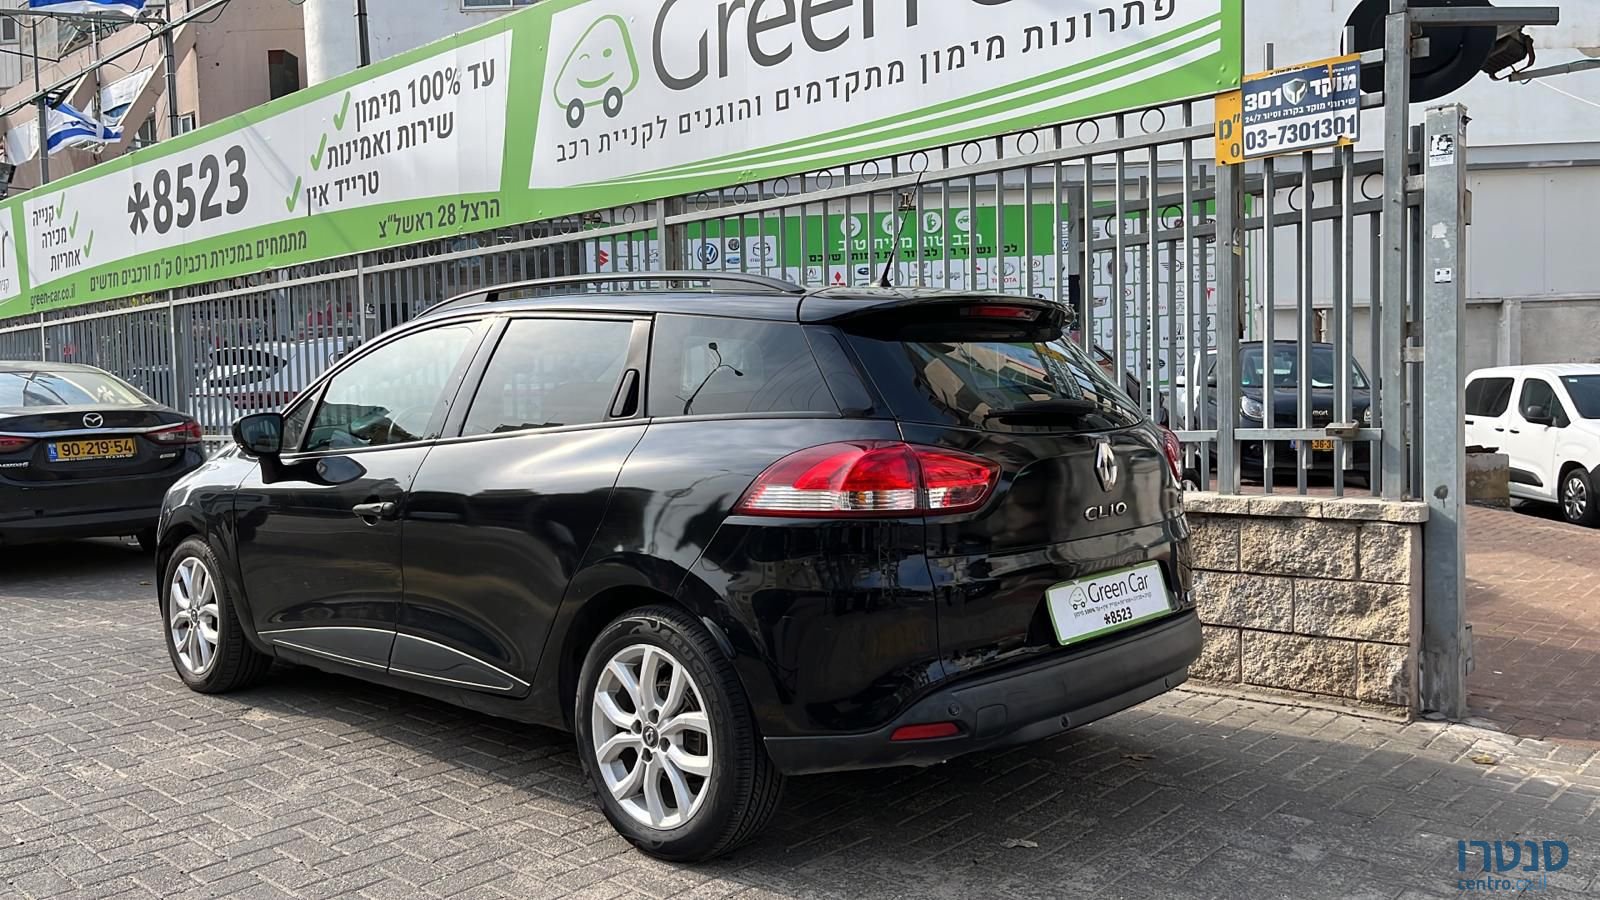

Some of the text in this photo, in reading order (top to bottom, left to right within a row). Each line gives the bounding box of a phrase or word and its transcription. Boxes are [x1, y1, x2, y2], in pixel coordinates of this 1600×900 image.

[556, 0, 1176, 163] פתרונות מימון מתקדמים והוגנים לקניית רכב
[354, 58, 495, 133] עד 100% מימון
[1244, 87, 1282, 112] 301
[1306, 102, 1326, 113] מוקד
[1245, 113, 1262, 124] 24/7
[1262, 110, 1281, 121] וסיור
[1283, 106, 1304, 117] בקרה
[327, 111, 454, 170] שירות ואמינות
[1245, 113, 1356, 151] 03-7301301
[306, 170, 379, 216] טרייד אין
[32, 204, 55, 227] קנייה
[438, 203, 456, 228] 28
[460, 198, 500, 224] הרצל
[41, 226, 67, 249] מכירה
[257, 230, 307, 258] מתמחים
[50, 248, 81, 272] אחריות
[210, 242, 253, 269] במכירת
[90, 269, 119, 292] חדשים
[121, 264, 151, 286] ורכבים
[1084, 501, 1128, 521] CLIO
[1087, 582, 1128, 603] Green
[1128, 572, 1149, 593] Car
